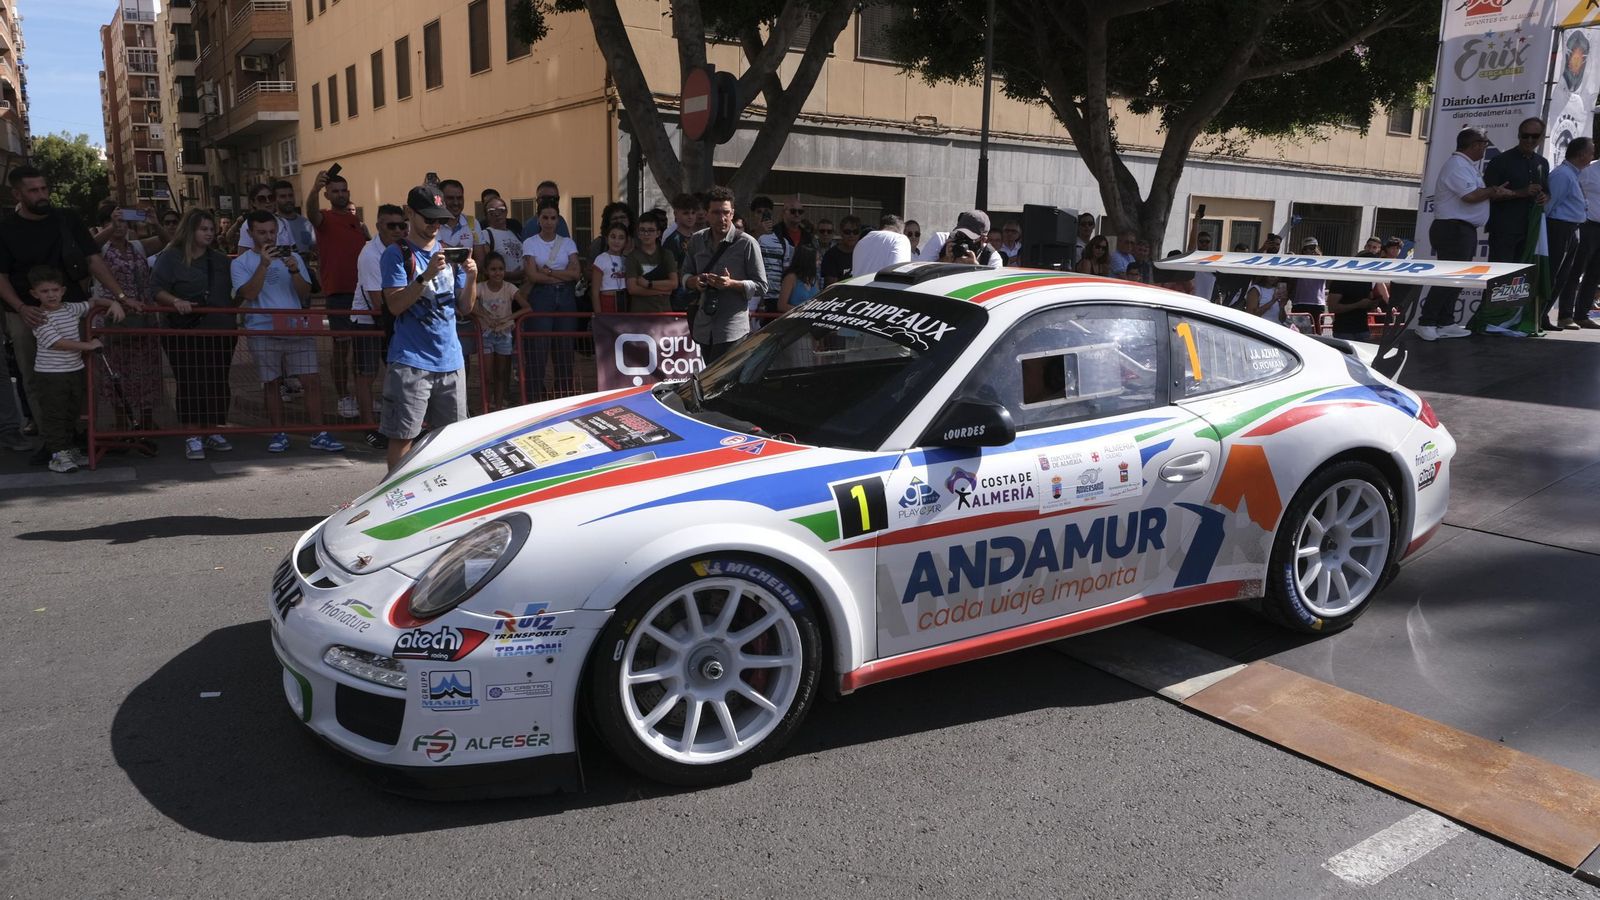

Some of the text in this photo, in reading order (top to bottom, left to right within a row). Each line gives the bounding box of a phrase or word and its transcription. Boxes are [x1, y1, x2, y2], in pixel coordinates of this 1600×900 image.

[1454, 38, 1531, 81] Enix
[1442, 90, 1536, 107] Diario de Almería
[1232, 255, 1435, 274] ANDAMUR
[821, 313, 876, 329] CONCEPT
[846, 300, 957, 342] CHIPEAUX
[1177, 322, 1203, 381] 1
[661, 358, 706, 375] con
[943, 424, 985, 440] LOURDES
[981, 472, 1032, 488] COSTA DE
[972, 483, 1034, 508] ALMERÍA
[851, 484, 871, 532] 1
[901, 506, 1168, 605] ANDAMUR
[725, 562, 799, 607] MICHELIN
[918, 598, 984, 631] cada
[1052, 566, 1138, 602] importa
[318, 600, 371, 633] frionature
[397, 626, 462, 650] atech
[494, 629, 568, 640] TRANSPORTES
[430, 652, 449, 660] racing
[420, 671, 429, 700] GRUPO
[465, 733, 551, 751] ALFESER
